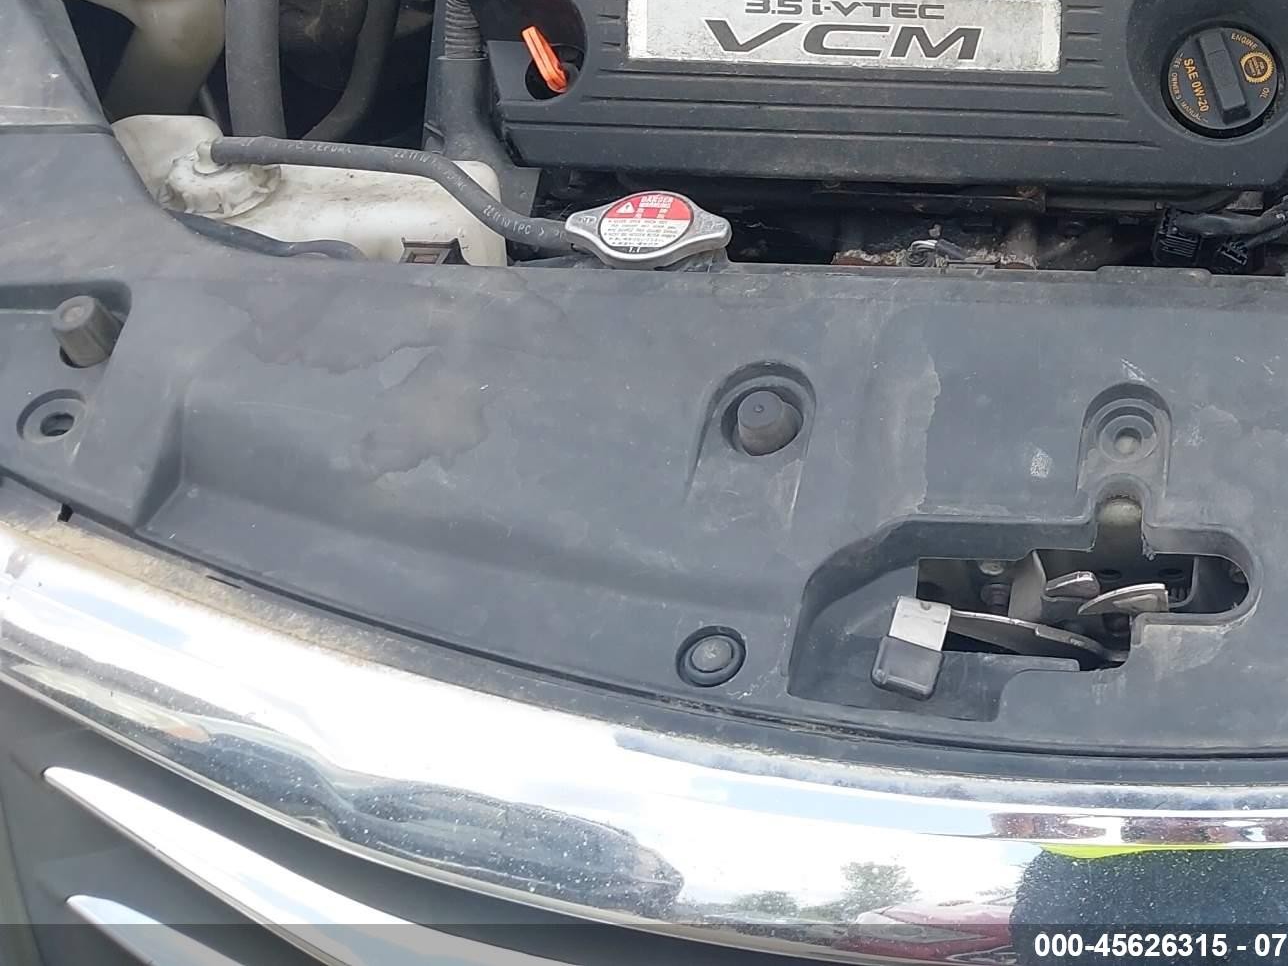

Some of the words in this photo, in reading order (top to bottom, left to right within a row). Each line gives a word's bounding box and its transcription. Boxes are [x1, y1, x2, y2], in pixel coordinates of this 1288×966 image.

[704, 18, 983, 61] VCM
[1231, 32, 1258, 50] ENGINE
[1183, 58, 1199, 81] SAE
[1191, 81, 1210, 113] 0W-20
[1260, 87, 1270, 99] OIL
